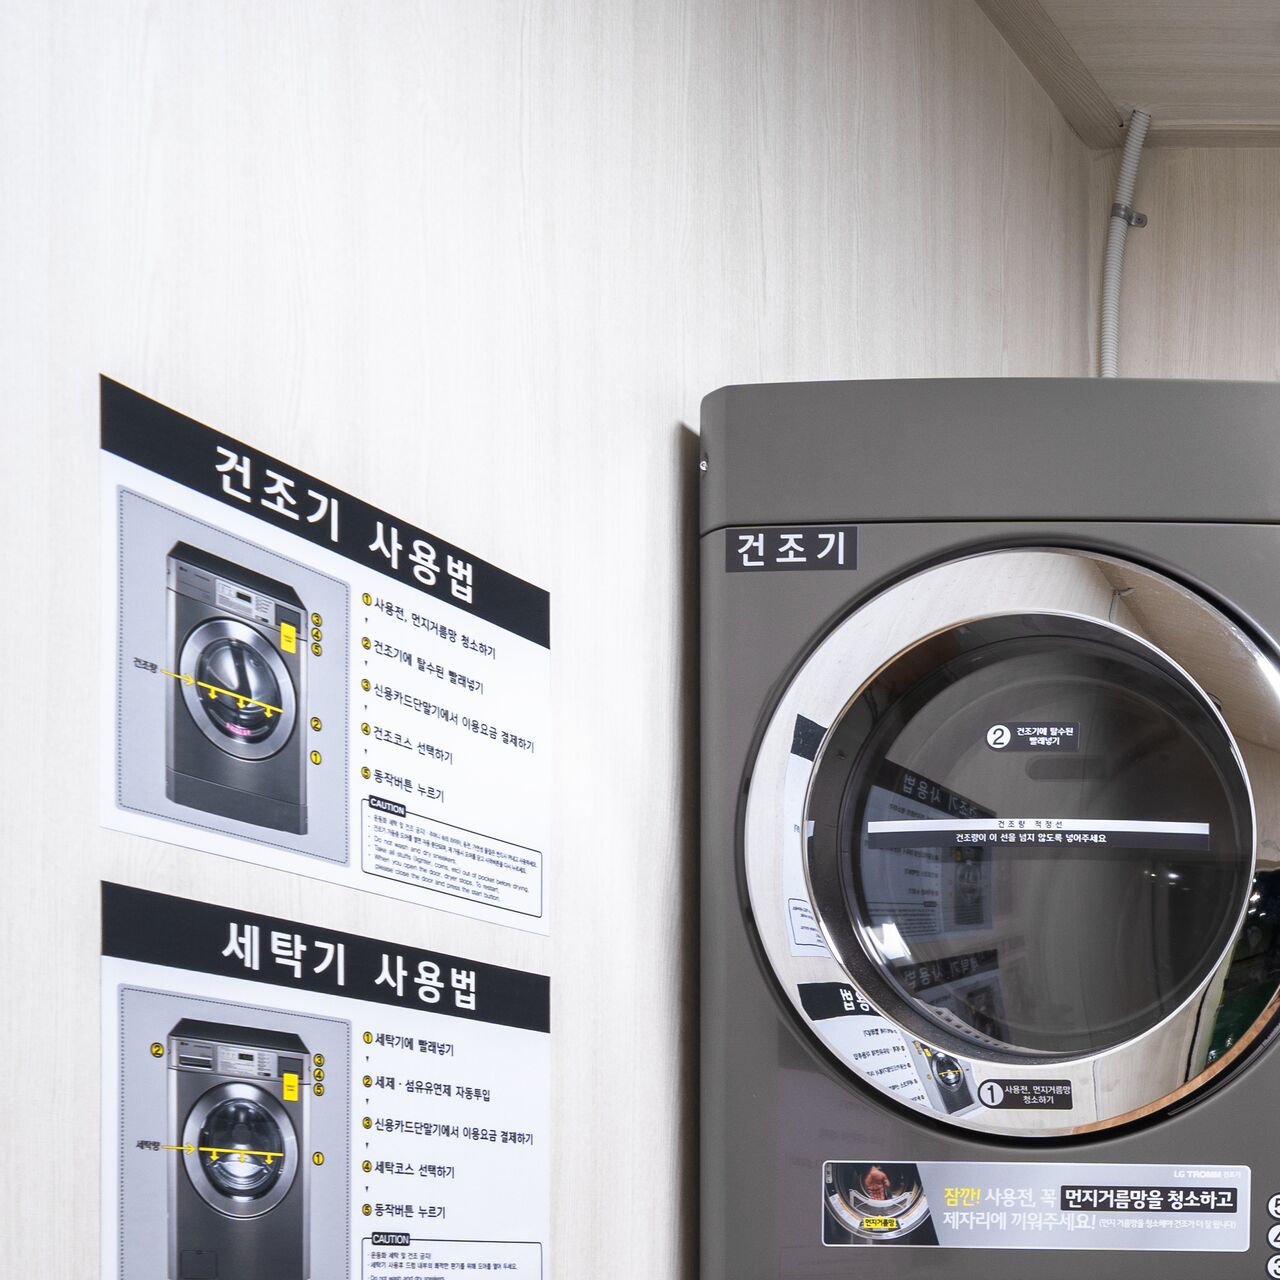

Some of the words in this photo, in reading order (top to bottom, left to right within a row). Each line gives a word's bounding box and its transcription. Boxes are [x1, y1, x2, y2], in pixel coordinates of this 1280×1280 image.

[215, 445, 340, 542] 건조기
[369, 521, 473, 604] 사용법
[738, 531, 845, 566] 건조기
[373, 597, 407, 622] 사용전,
[411, 613, 457, 643] 먼지거름망
[461, 634, 496, 660] 청소하기
[373, 640, 412, 666] 건조기에
[417, 657, 444, 679] 탈수된
[448, 670, 484, 695] 빨래넣기
[373, 684, 458, 726] 신용카드단말기에서
[462, 715, 497, 740] 이용요금
[501, 730, 535, 754] 결제하기
[1016, 727, 1048, 737] 건조기에
[1050, 726, 1074, 737] 탈수된
[1029, 737, 1060, 747] 빨래넣기
[373, 726, 413, 750] 건조코스
[417, 741, 453, 765] 선택하기
[373, 768, 413, 794] 동작버튼
[417, 783, 444, 803] 누르기
[370, 798, 405, 816] CAUTION
[956, 833, 987, 844] 건조량이
[989, 833, 998, 843] 이
[1000, 833, 1017, 843] 선을
[1019, 833, 1035, 843] 넘지
[1038, 833, 1063, 844] 않도록
[1065, 833, 1107, 844] 넣어주세요
[222, 922, 346, 986] 세탁기
[374, 956, 477, 1011] 사용법
[375, 1033, 414, 1051] 세탁기에
[418, 1039, 454, 1056] 빨래넣기
[375, 1076, 395, 1090] 세제
[405, 1079, 451, 1097] 섬유유연제
[456, 1086, 490, 1102] 자동투입
[1023, 1095, 1054, 1106] 청소하기
[1032, 1085, 1071, 1096] 먼지거름망
[375, 1118, 459, 1138] 신용카드단말기에서
[463, 1127, 497, 1142] 이용요금
[500, 1131, 534, 1146] 결제하기
[374, 1161, 414, 1176] 세탁코스
[418, 1164, 455, 1179] 선택하기
[943, 1187, 981, 1208] 잠깐!
[1039, 1188, 1058, 1209] 꼭
[1064, 1189, 1162, 1210] 먼지거름망을
[1167, 1190, 1234, 1210] 청소하고
[374, 1203, 414, 1218] 동작버튼
[418, 1206, 446, 1220] 누르기
[943, 1211, 1007, 1231] 제자리에
[1010, 1212, 1097, 1232] 끼워주세요!
[372, 1234, 409, 1245] CAUTION
